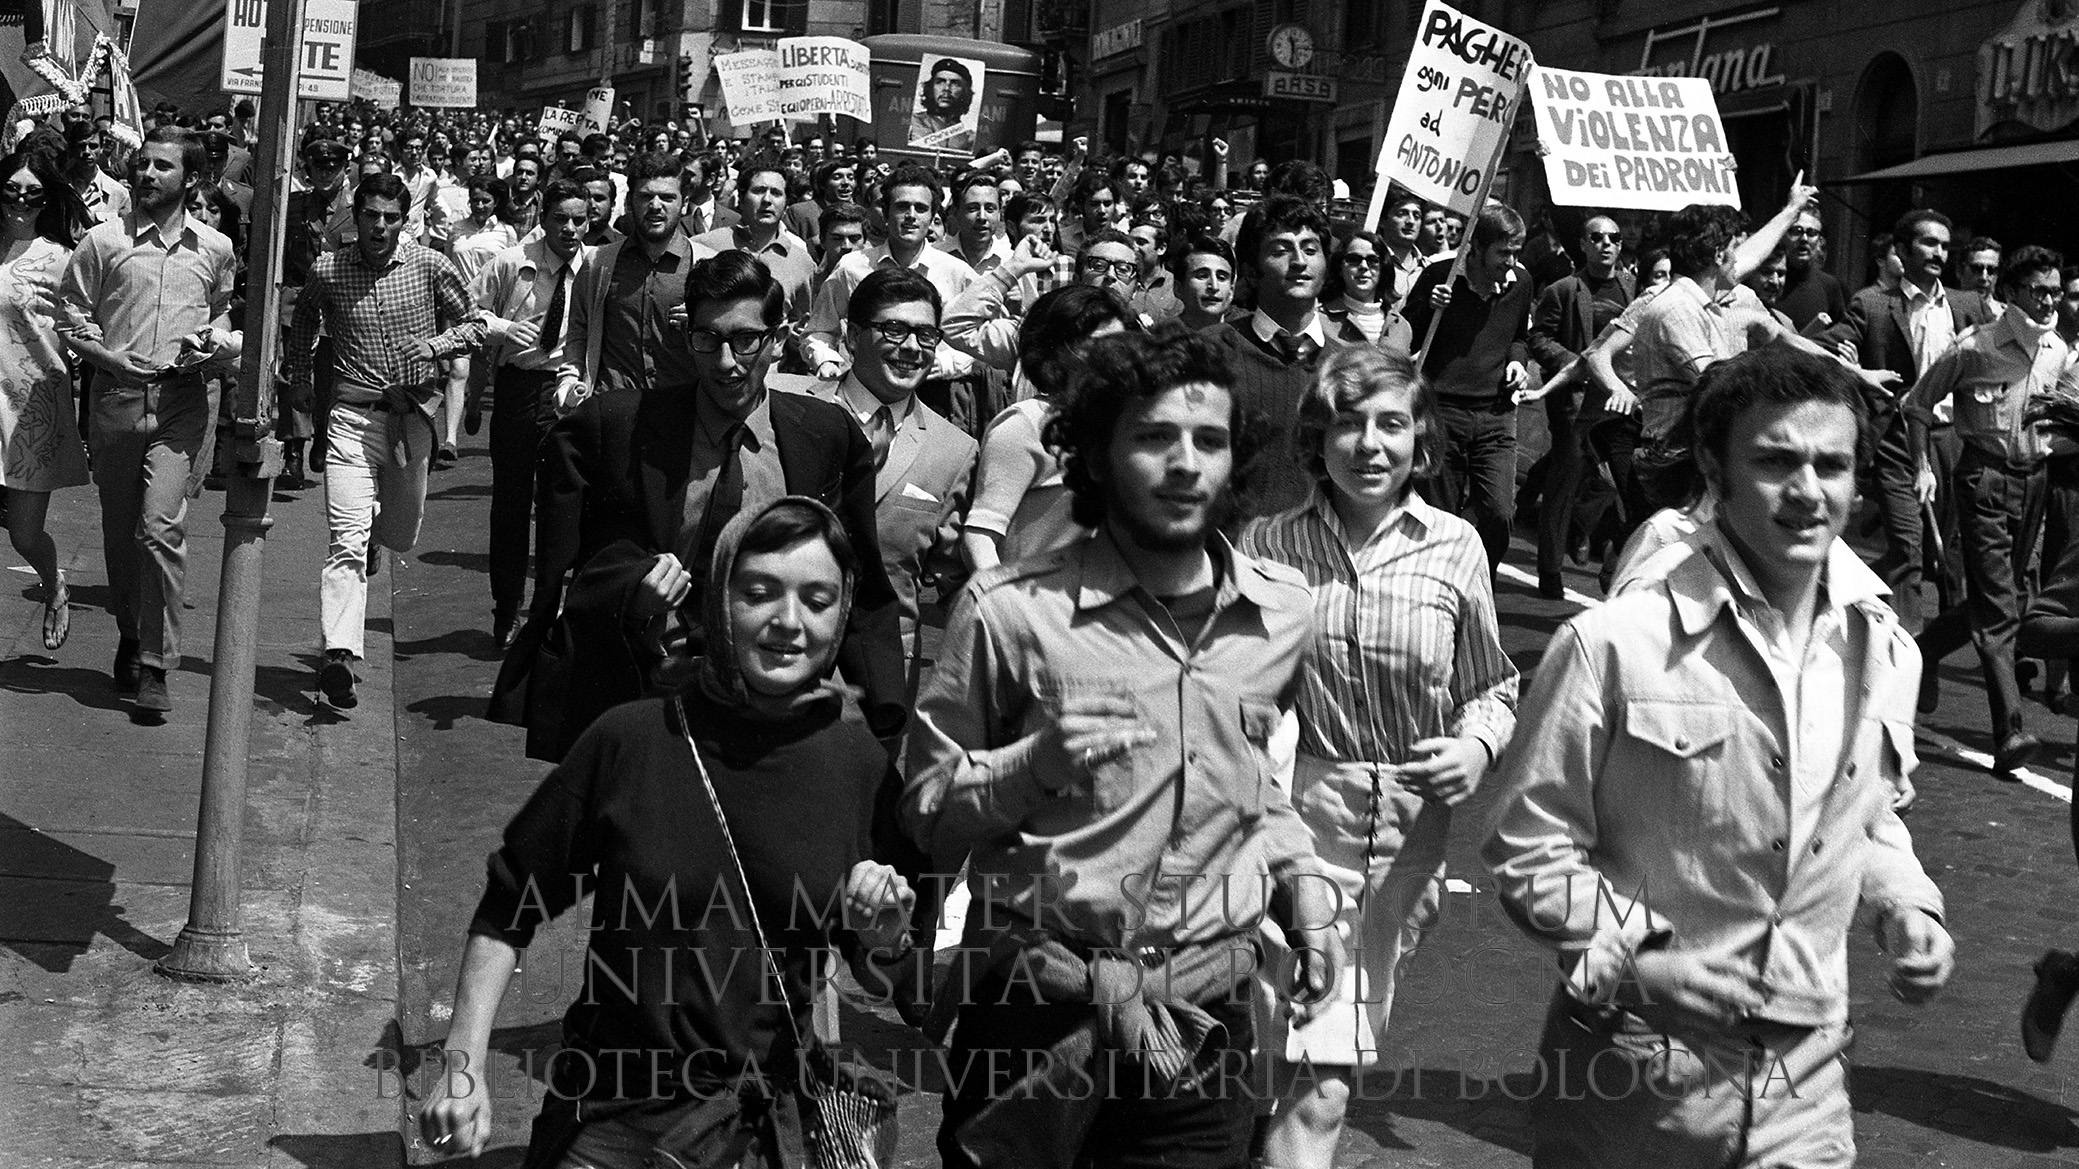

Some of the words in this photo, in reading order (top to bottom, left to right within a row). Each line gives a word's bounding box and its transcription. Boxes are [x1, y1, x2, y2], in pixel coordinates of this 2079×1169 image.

[305, 18, 352, 36] PENSIONE
[304, 41, 341, 71] TE
[1417, 66, 1450, 92] ogni
[1541, 73, 1591, 102] NO
[1604, 79, 1685, 109] ALLA
[544, 108, 556, 120] LA
[1420, 109, 1443, 137] ad
[1397, 133, 1481, 195] ANTONIO
